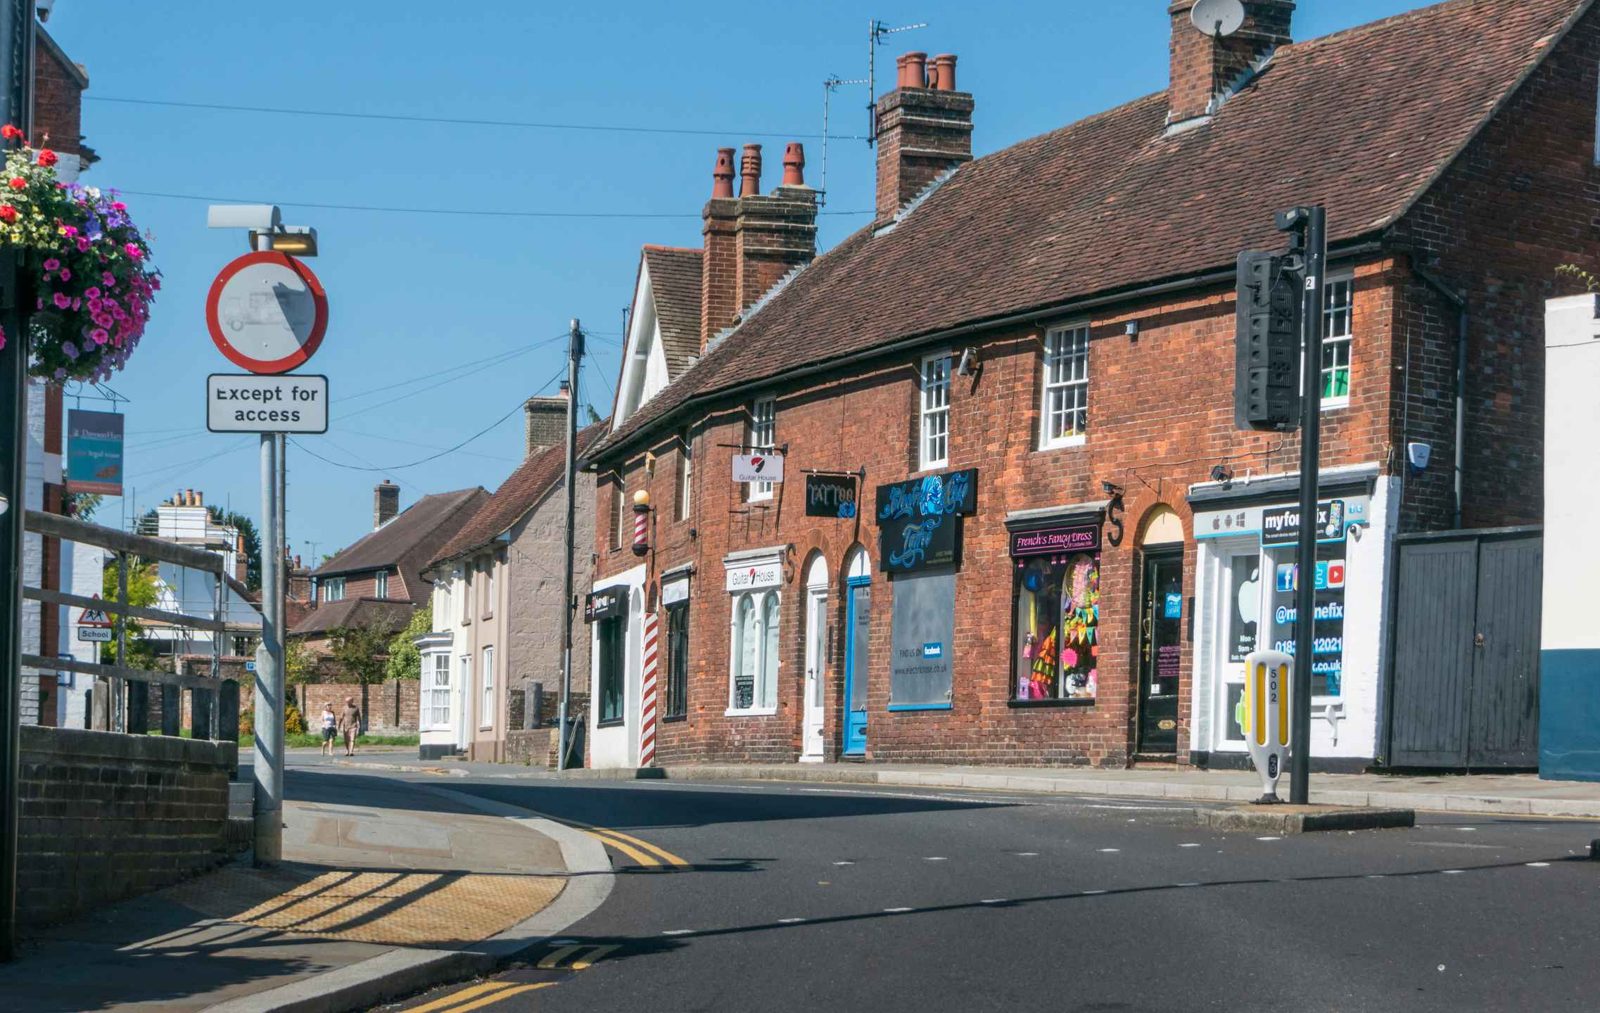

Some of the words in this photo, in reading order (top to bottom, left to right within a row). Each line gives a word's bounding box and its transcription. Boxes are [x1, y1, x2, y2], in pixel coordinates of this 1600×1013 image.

[1306, 278, 1312, 288] 2
[217, 386, 282, 404] Except
[291, 386, 318, 401] for
[235, 410, 301, 422] access
[1016, 532, 1048, 548] French's
[1048, 534, 1071, 549] Fancy
[1071, 532, 1093, 542] Dress
[732, 572, 748, 586] Guitar
[756, 570, 775, 583] House
[82, 630, 109, 639] School
